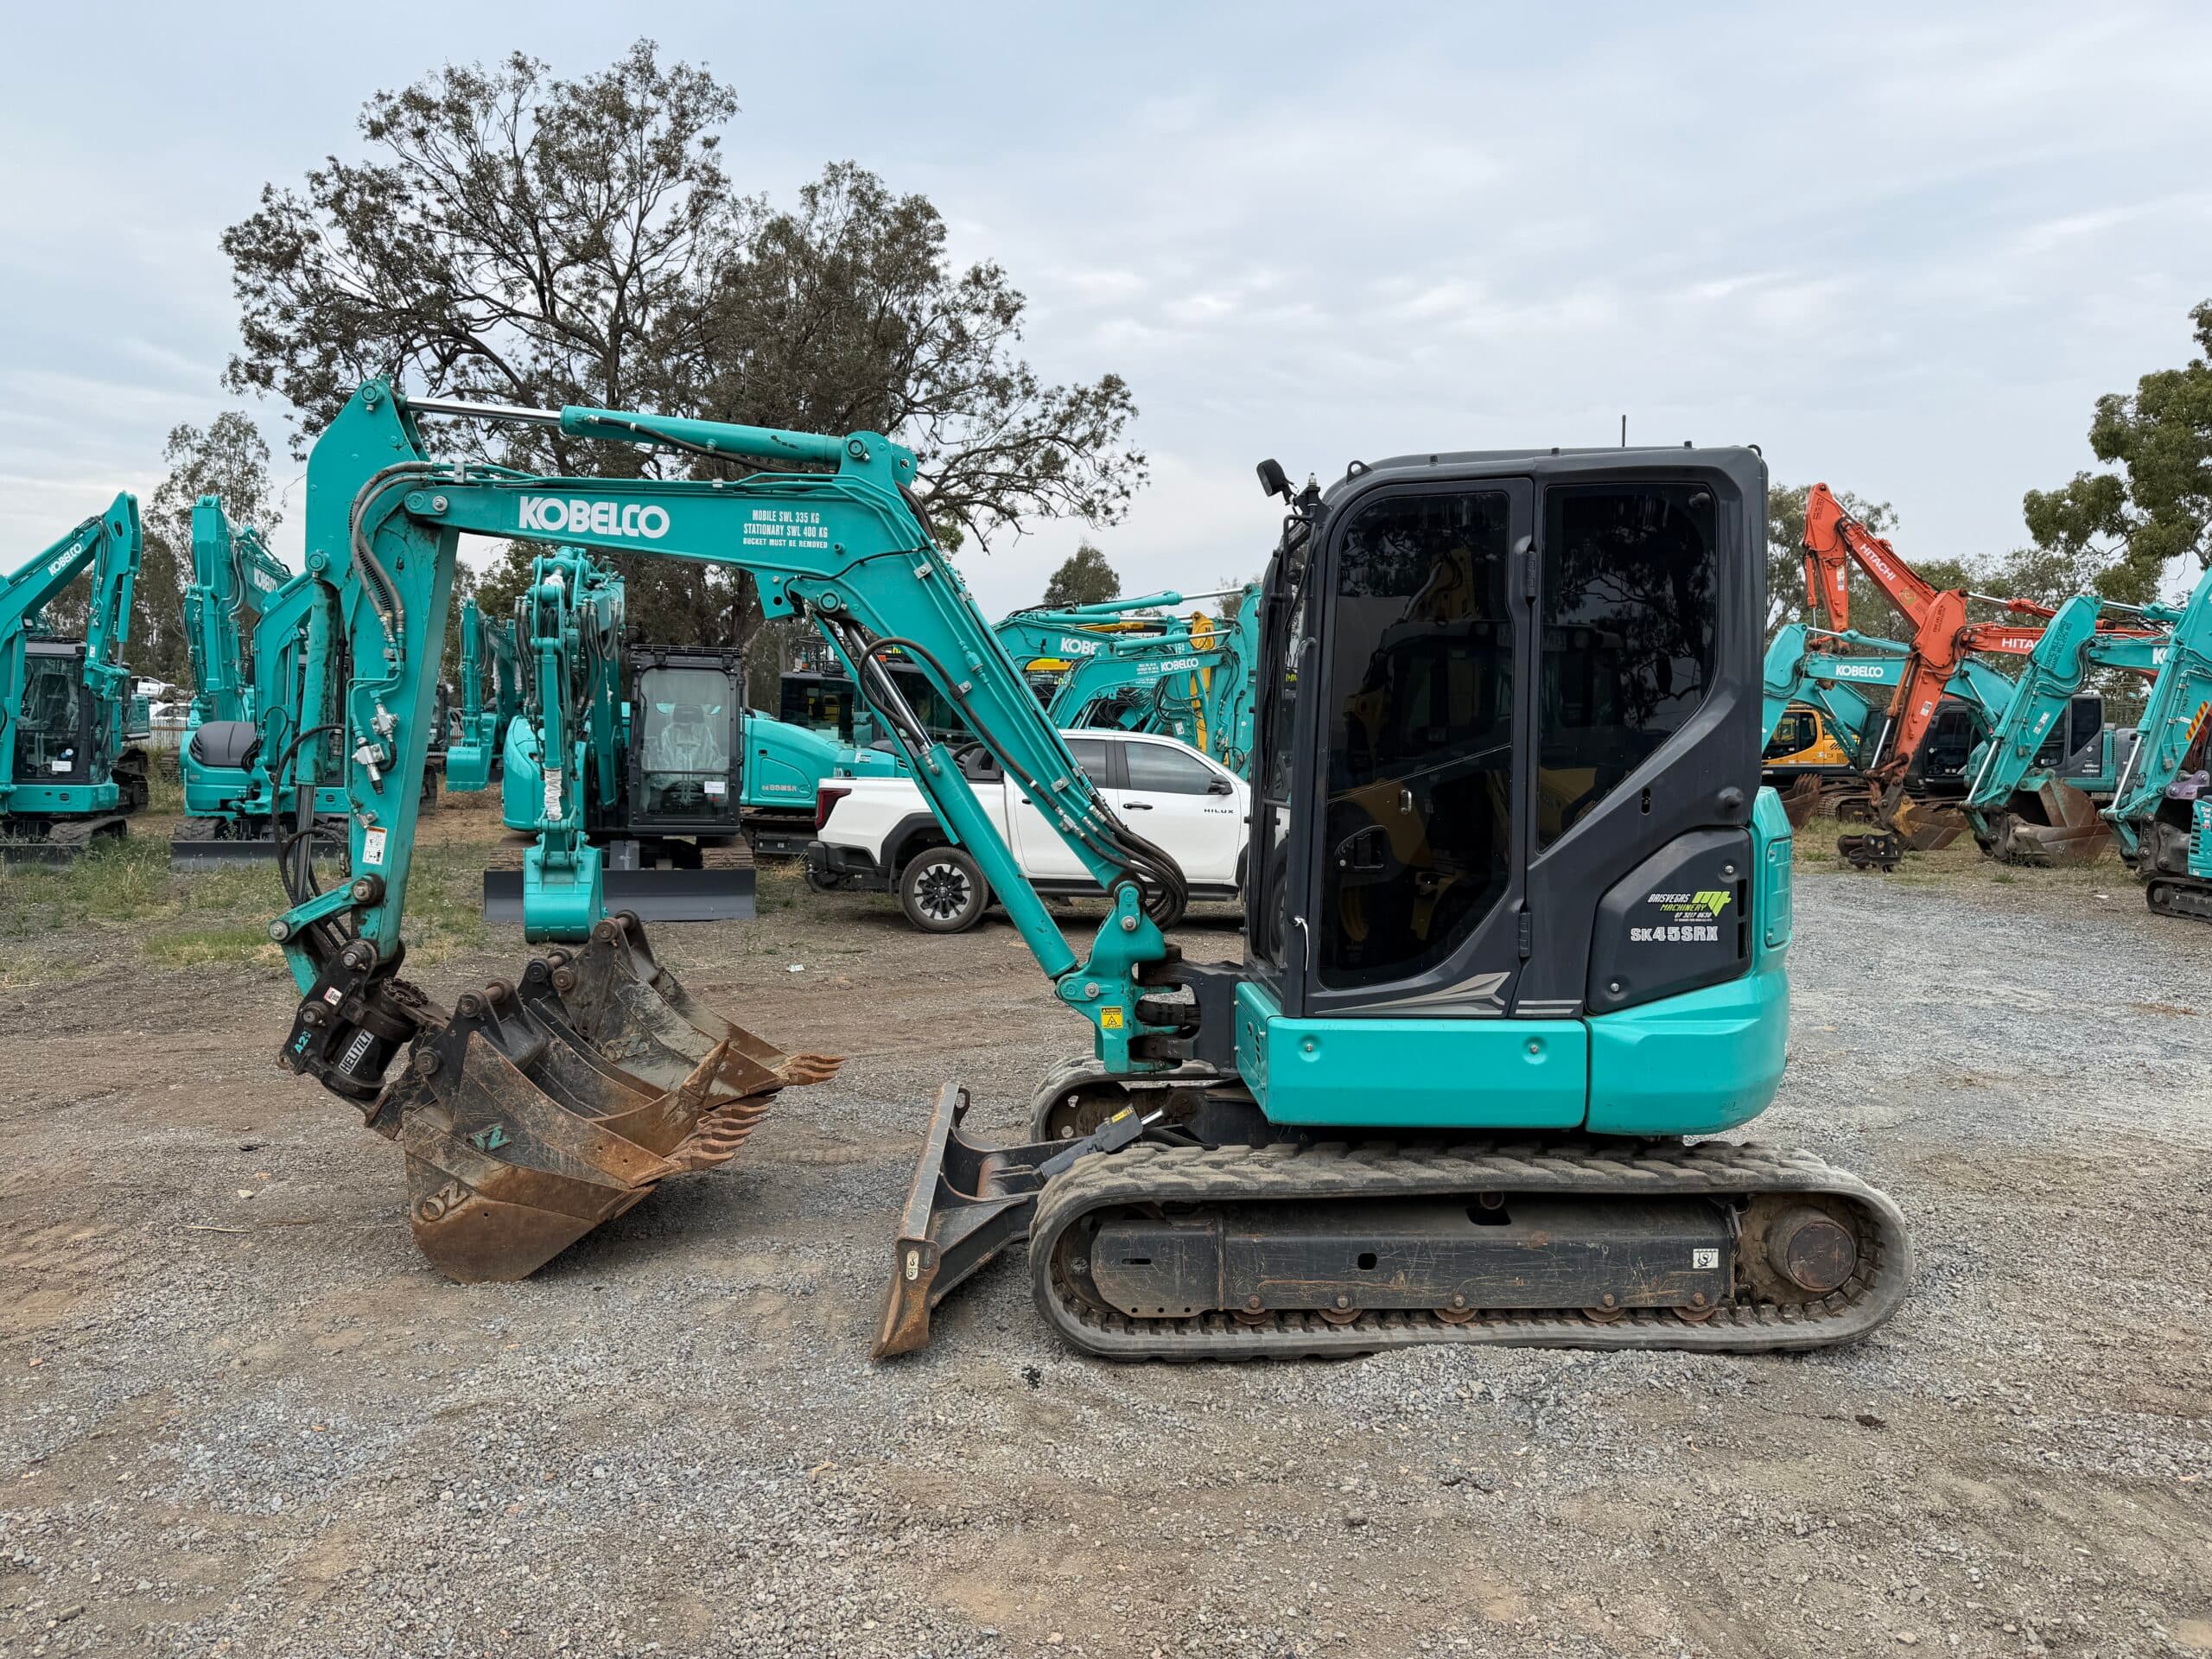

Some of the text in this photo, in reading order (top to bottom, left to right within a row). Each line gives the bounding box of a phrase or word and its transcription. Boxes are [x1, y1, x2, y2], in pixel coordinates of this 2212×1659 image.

[518, 495, 671, 539] KOBELCO
[753, 510, 820, 524] MOBILE SWL 335 KG
[743, 523, 828, 537] STATIONARY SWL 400 KG
[798, 540, 828, 549] REMOVED
[48, 543, 82, 576] KOBELCO
[1859, 543, 1897, 581] HITACHI
[1060, 637, 1103, 655] KOBE
[2001, 638, 2039, 648] HITA
[1160, 658, 1199, 671] KOBELCO
[1835, 664, 1884, 677] KOBELCO
[1647, 893, 1691, 903] BRISVEGAS
[1630, 925, 1719, 942] SK45SRX
[340, 1030, 373, 1074] HELITILT
